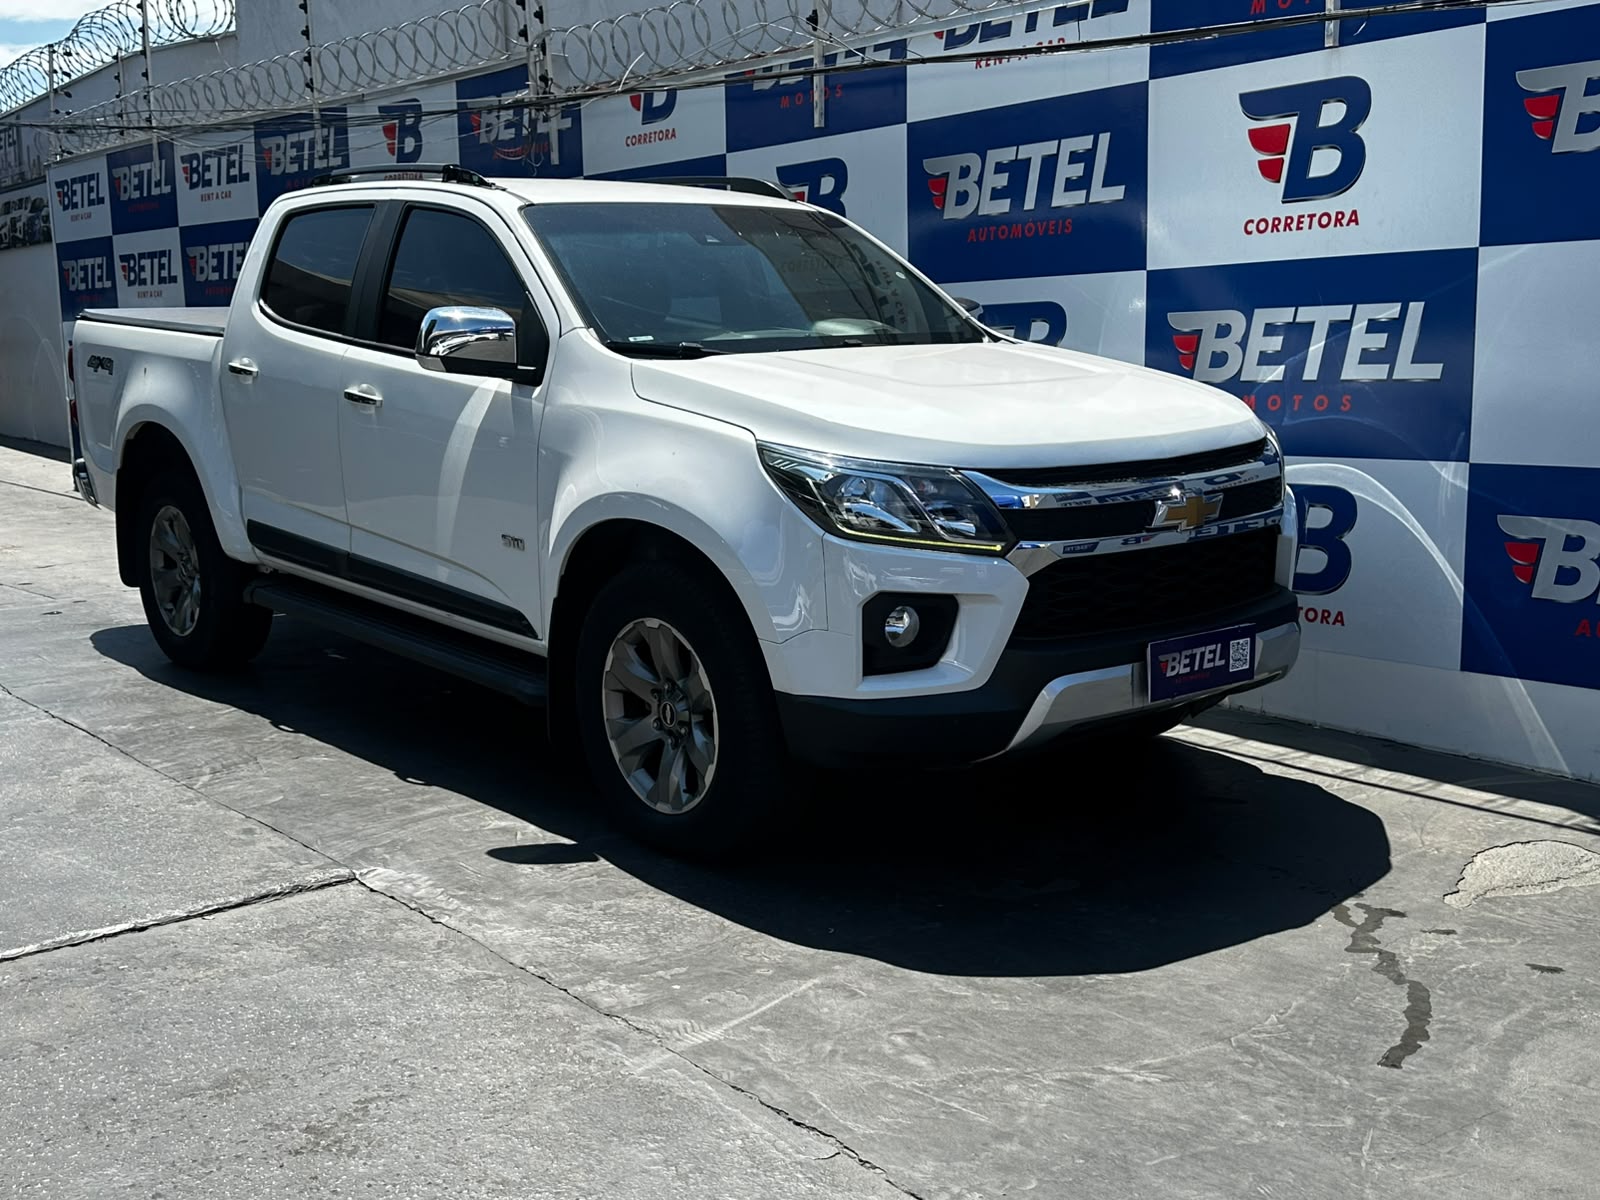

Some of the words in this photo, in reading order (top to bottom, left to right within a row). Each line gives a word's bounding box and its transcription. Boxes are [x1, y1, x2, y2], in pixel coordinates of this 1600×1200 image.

[260, 125, 343, 176] BETEL
[625, 127, 677, 147] CORRETORA
[112, 159, 171, 201] BETEL
[179, 144, 250, 190] BETEL
[922, 132, 1125, 221] BETEL
[54, 172, 105, 212] BETEL
[201, 192, 215, 202] RENT
[221, 190, 232, 200] CAR
[968, 218, 1073, 243] AUTOMÓVEIS
[1243, 209, 1360, 236] CORRETORA
[62, 256, 112, 291] BETEL
[119, 249, 178, 287] BETEL
[186, 241, 249, 282] BETE
[1167, 301, 1444, 382] BETEL
[1242, 394, 1352, 411] MOTOS
[1158, 643, 1226, 677] BETEL
